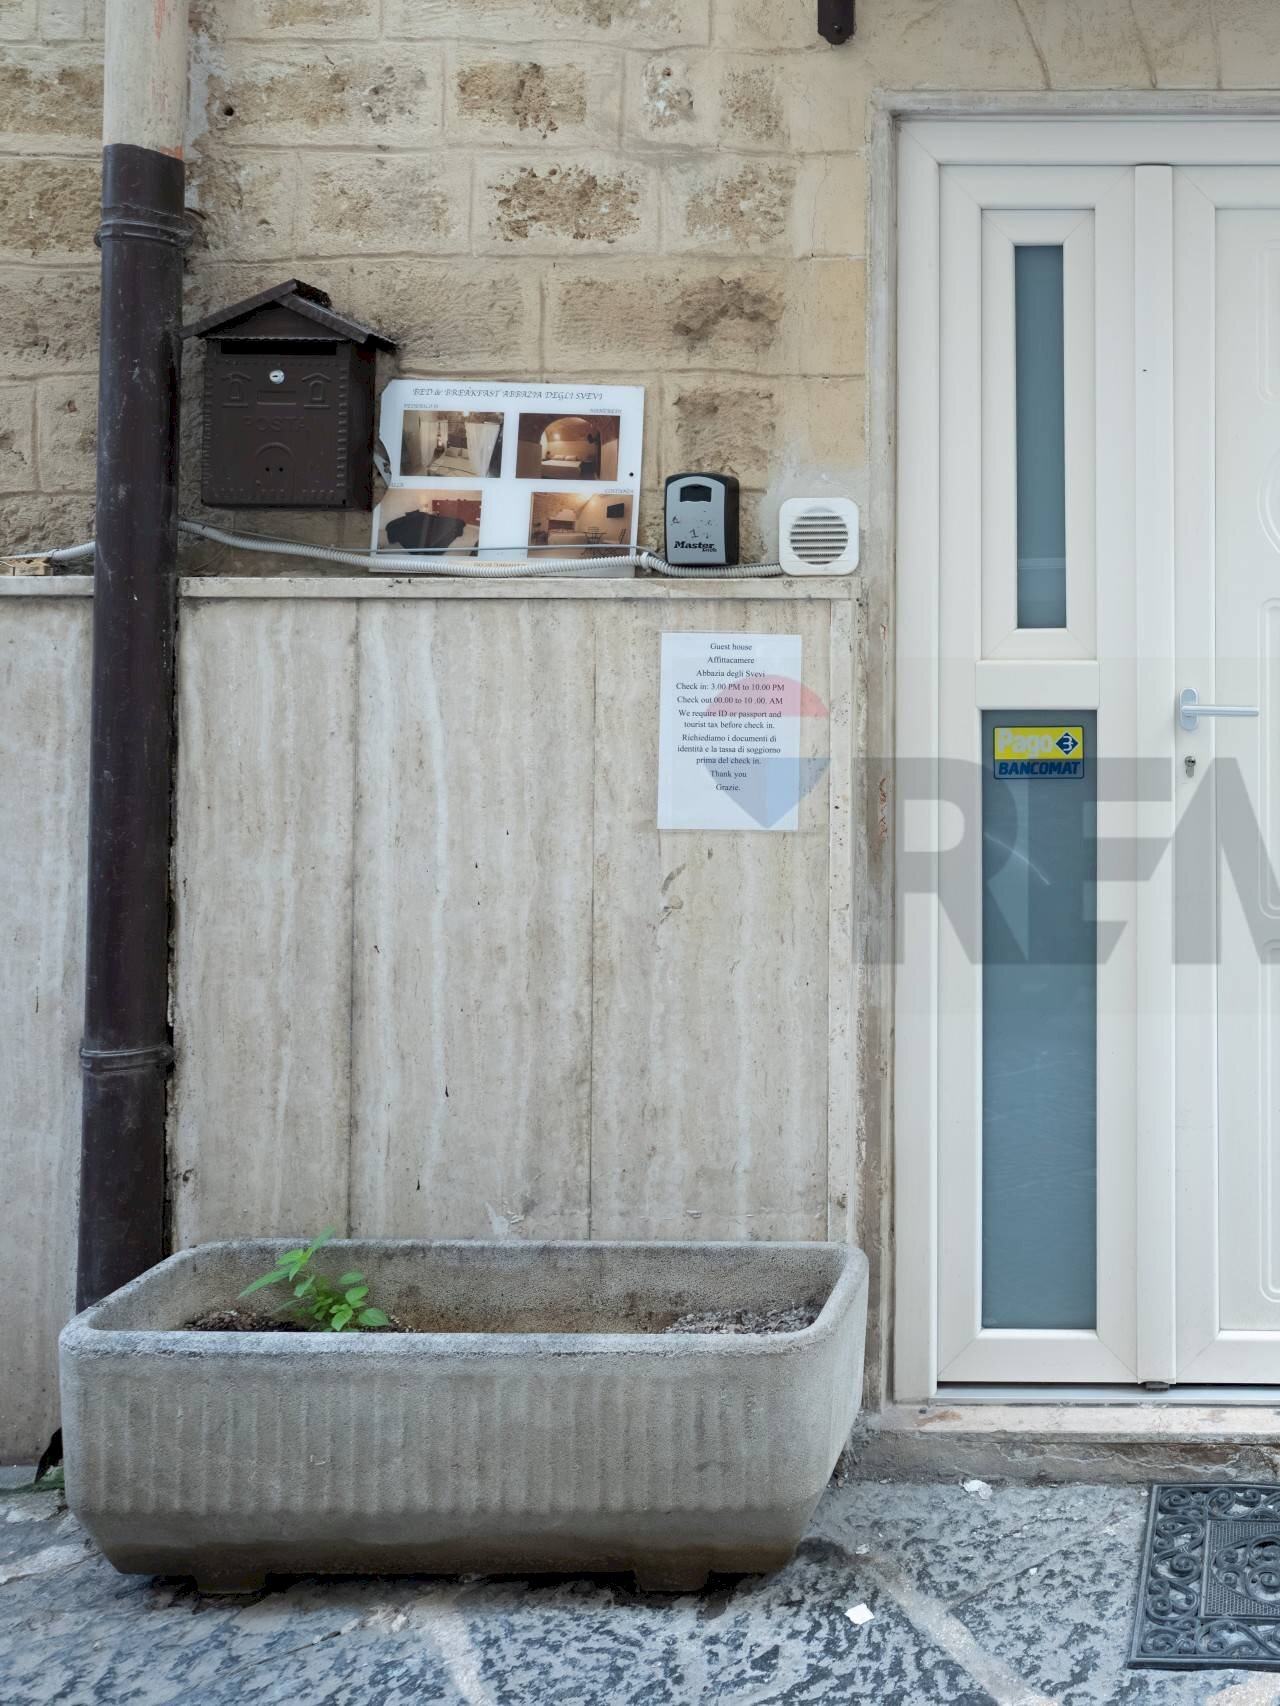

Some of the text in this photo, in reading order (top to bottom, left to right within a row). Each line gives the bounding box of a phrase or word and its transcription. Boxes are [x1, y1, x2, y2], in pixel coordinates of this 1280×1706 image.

[445, 388, 500, 398] BREAKFAST
[674, 541, 714, 549] Master
[710, 643, 730, 651] Guest
[727, 670, 744, 679] degli
[721, 721, 742, 729] before
[682, 734, 725, 742] Richiediamo
[998, 728, 1053, 759] Pago
[747, 747, 781, 755] soggiorno
[696, 757, 716, 765] prima
[998, 762, 1080, 775] BANCOMAT
